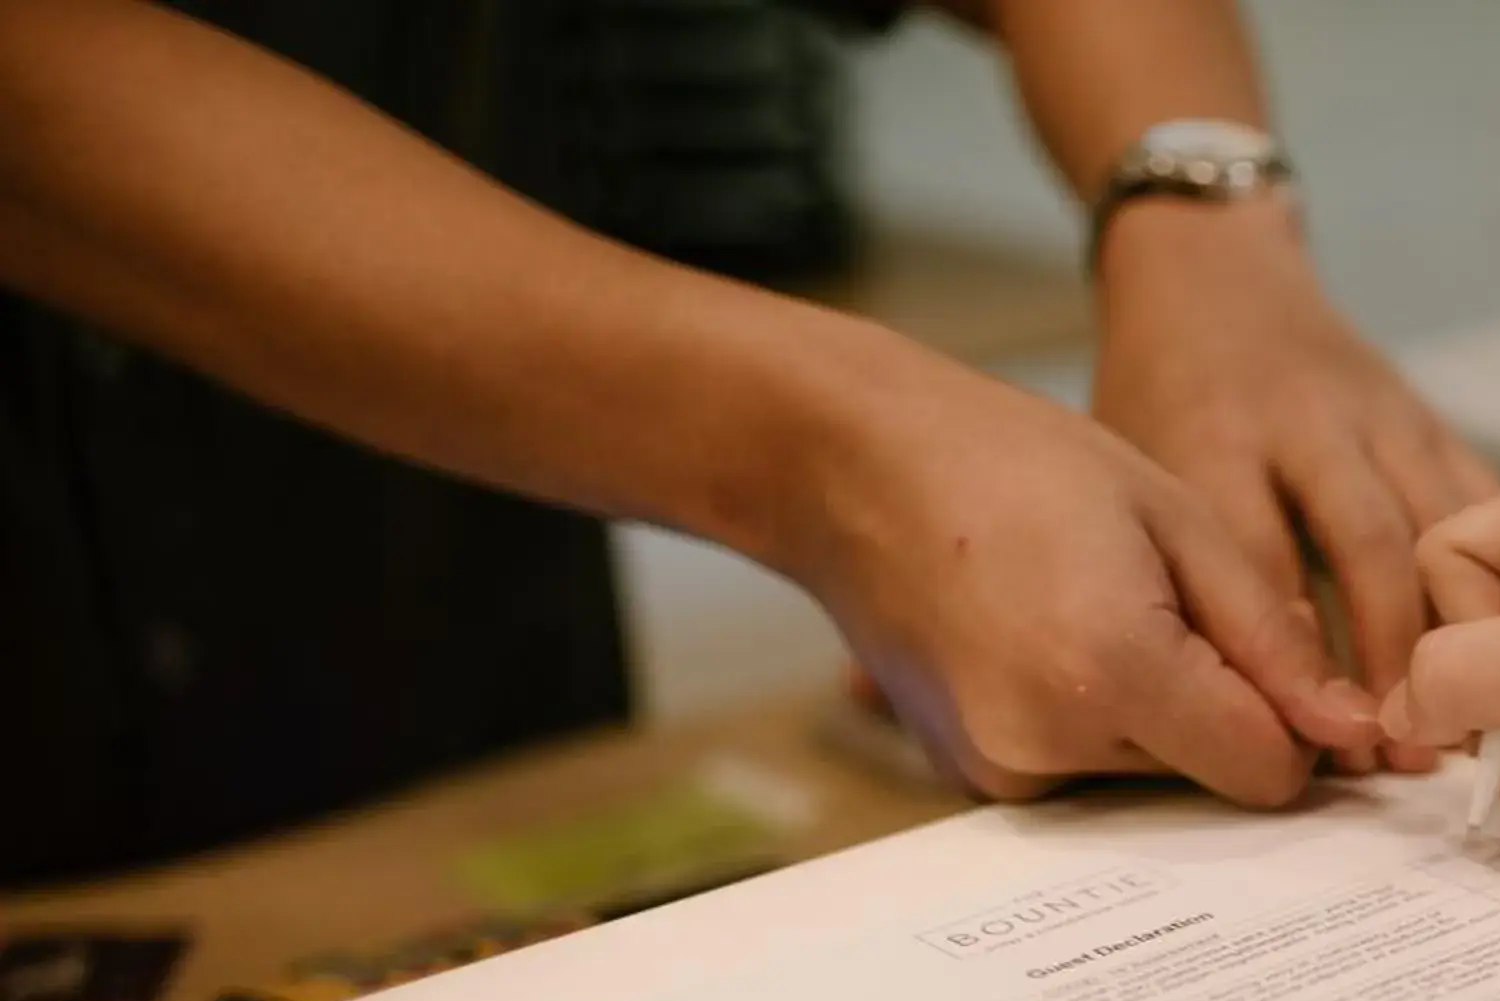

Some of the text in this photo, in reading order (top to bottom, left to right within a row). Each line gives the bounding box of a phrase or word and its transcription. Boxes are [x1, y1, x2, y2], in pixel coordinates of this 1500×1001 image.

[946, 872, 1151, 947] BOUNTIE
[1026, 952, 1095, 980] Guest
[1093, 911, 1215, 957] Declaration
